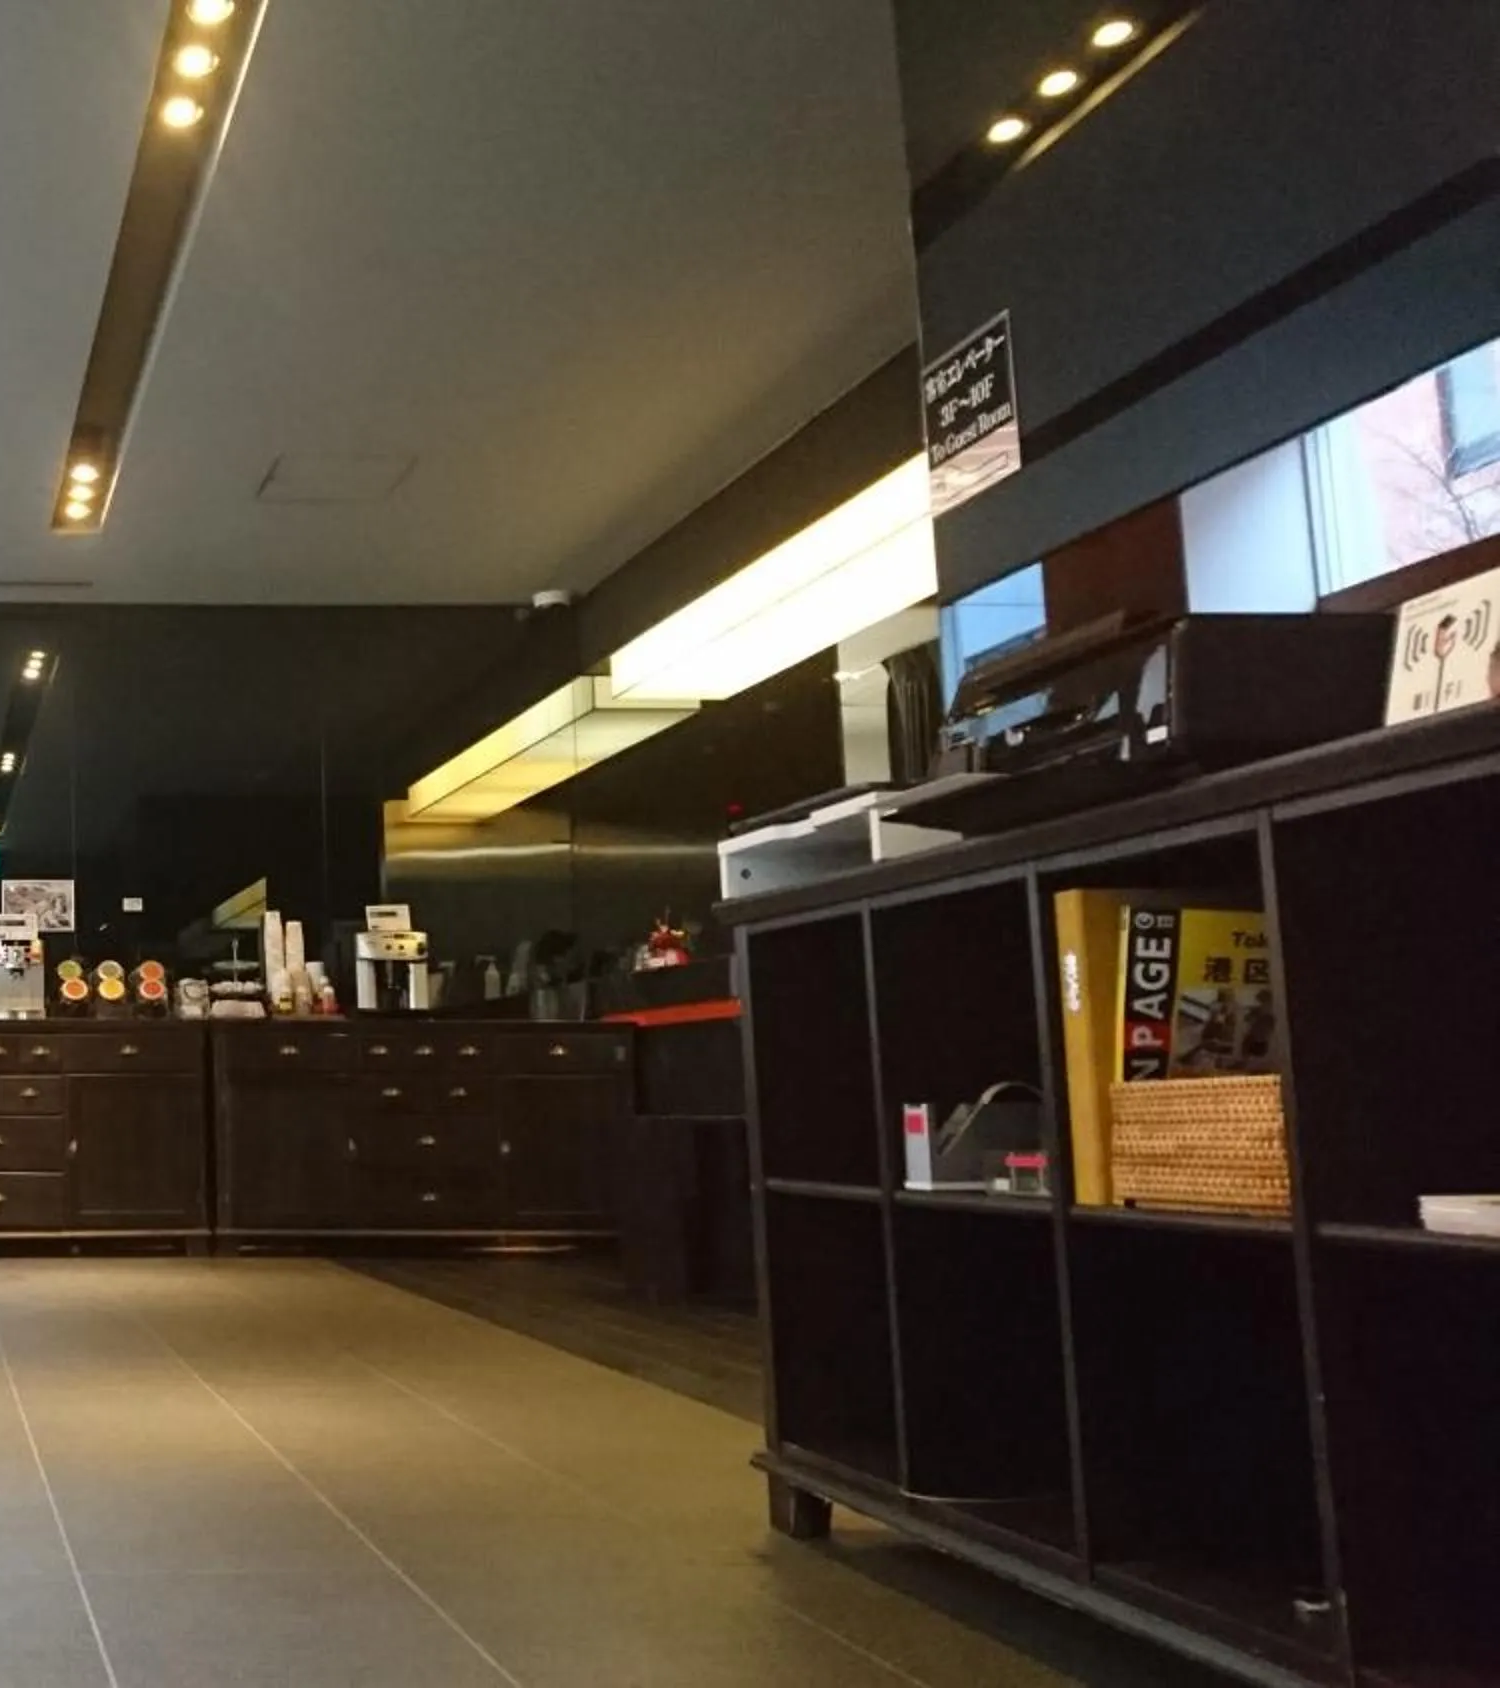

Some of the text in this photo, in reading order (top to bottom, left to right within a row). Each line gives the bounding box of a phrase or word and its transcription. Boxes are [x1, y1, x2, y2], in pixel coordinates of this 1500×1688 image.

[931, 402, 1012, 464] To Guest Room
